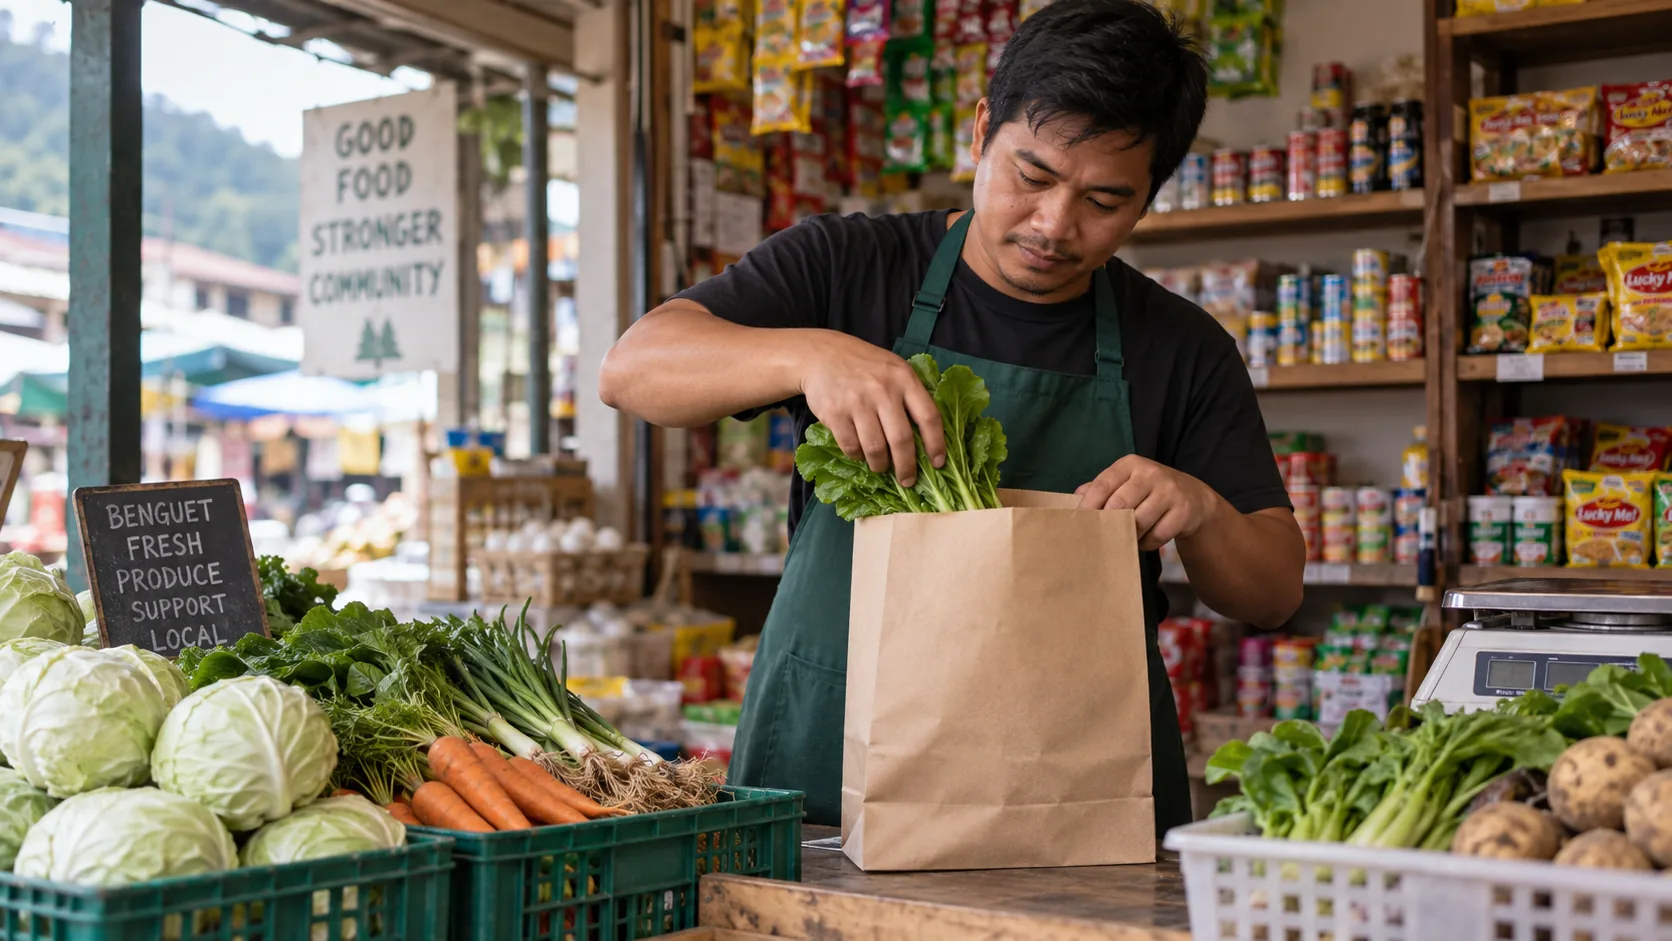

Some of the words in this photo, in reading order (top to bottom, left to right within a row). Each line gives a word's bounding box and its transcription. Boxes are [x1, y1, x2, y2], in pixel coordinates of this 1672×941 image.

[335, 114, 415, 159] GOOD
[337, 160, 413, 204] FOOD
[311, 208, 443, 256] STRONGER
[308, 259, 445, 306] COMMUNITY
[1626, 271, 1666, 288] Lucky
[106, 498, 213, 530] BENGUET
[1577, 507, 1613, 524] Lucky
[1614, 507, 1638, 521] Me!
[126, 531, 203, 561] FRESH
[115, 561, 223, 594] PRODUCE
[131, 593, 227, 623] SUPPORT
[150, 623, 228, 652] LOCAL
